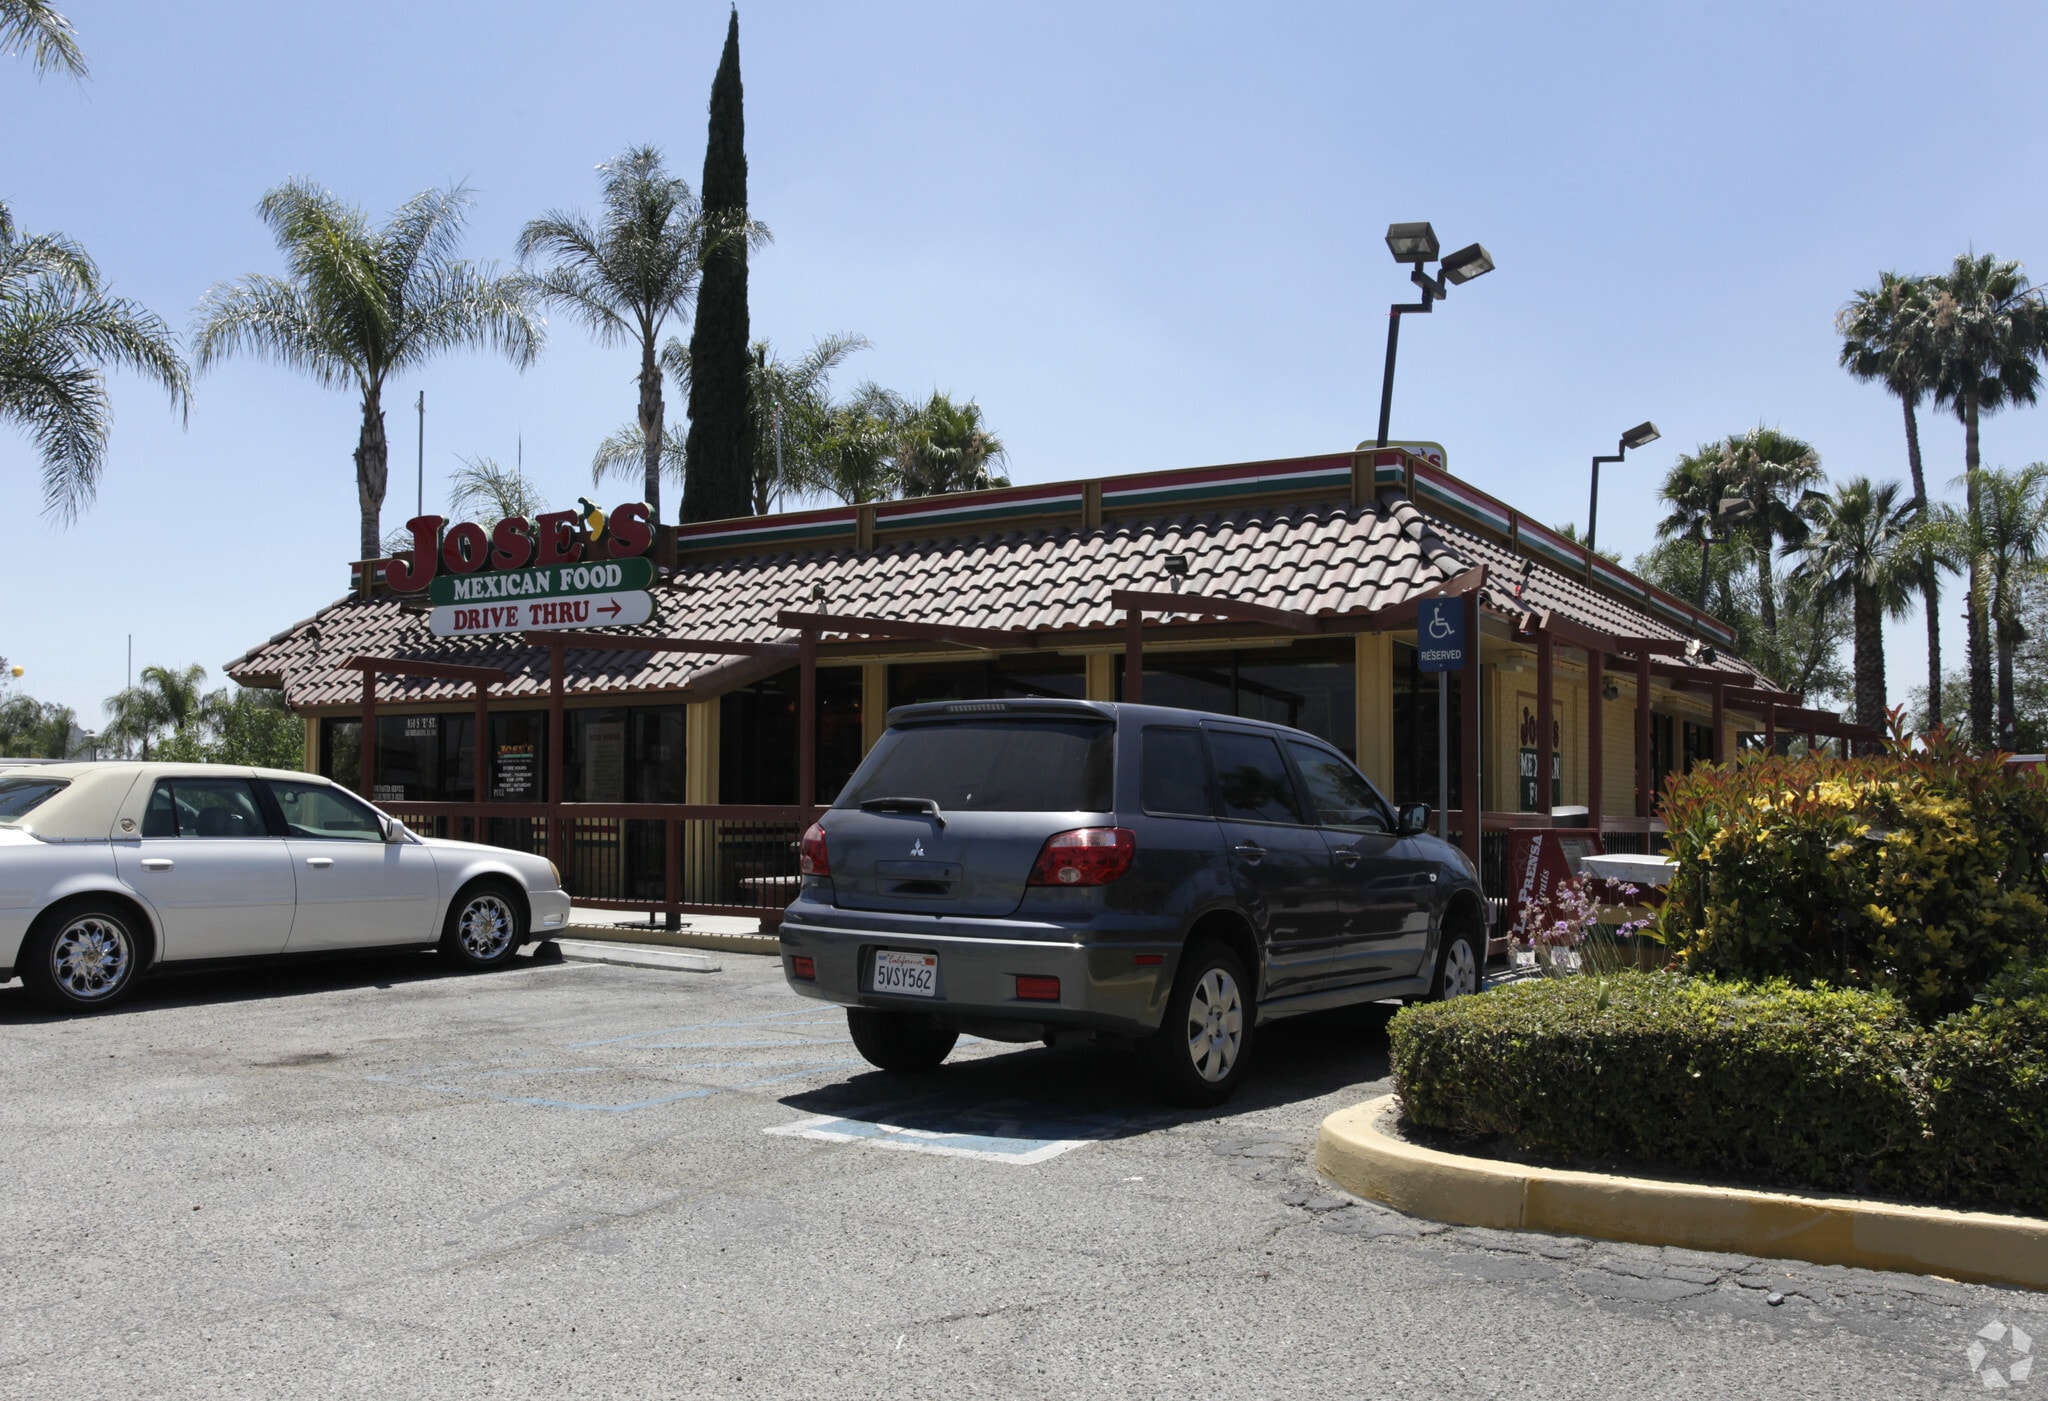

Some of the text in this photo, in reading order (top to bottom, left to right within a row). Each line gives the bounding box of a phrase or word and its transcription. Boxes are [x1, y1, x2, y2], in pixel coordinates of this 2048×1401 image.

[385, 497, 655, 592] JOSE'S
[453, 564, 622, 600] MEXICAN FOOD
[453, 600, 590, 630] DRIVE THRU
[1421, 650, 1461, 661] RESERVED
[496, 743, 535, 755] JOSE'S
[1518, 834, 1543, 903] PRENSA
[888, 954, 925, 967] California
[878, 965, 933, 989] 5VSY562
